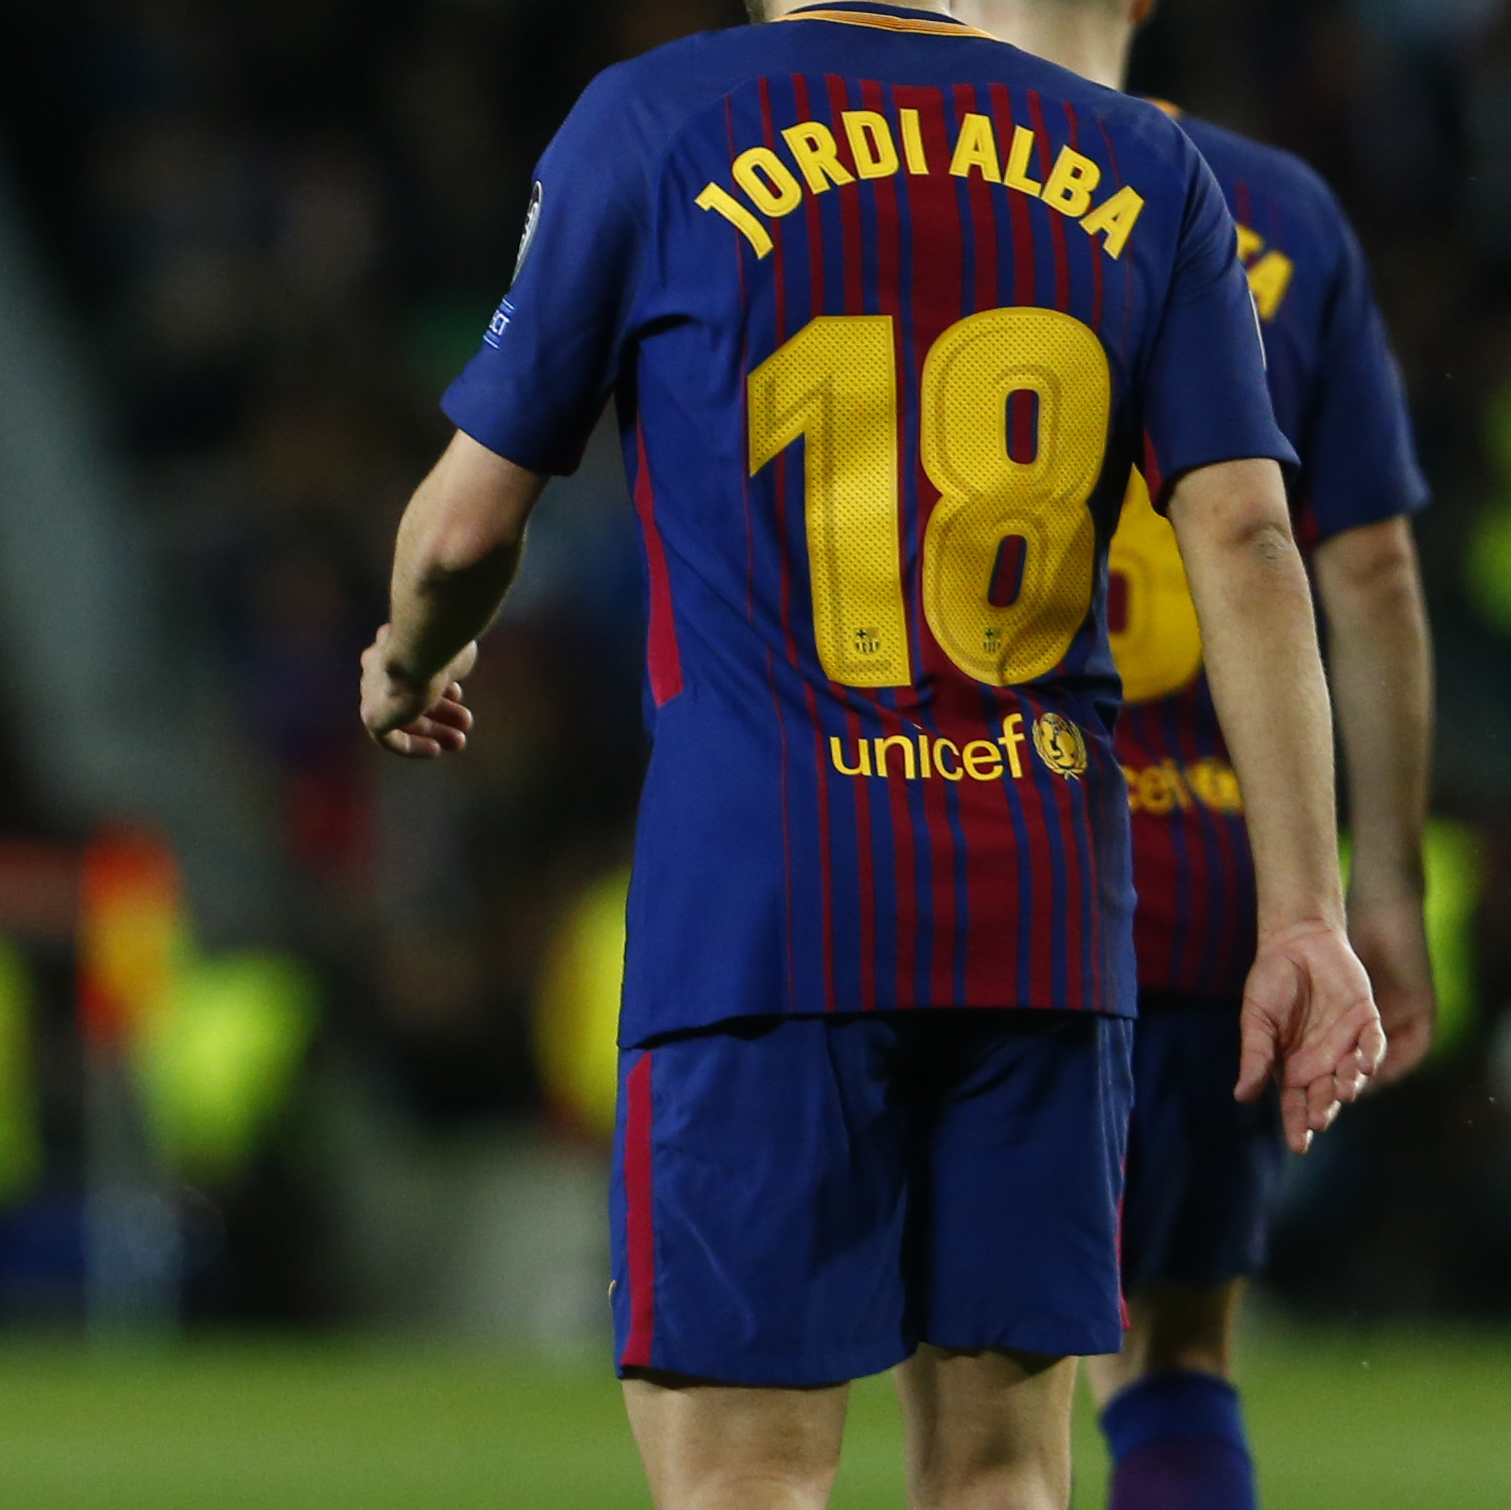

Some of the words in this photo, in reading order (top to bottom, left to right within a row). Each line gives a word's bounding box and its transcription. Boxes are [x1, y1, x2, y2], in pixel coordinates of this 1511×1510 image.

[695, 107, 930, 259] JORDI
[948, 112, 1145, 260] ALBA
[746, 305, 1112, 688] 18
[829, 711, 1026, 783] unicef
